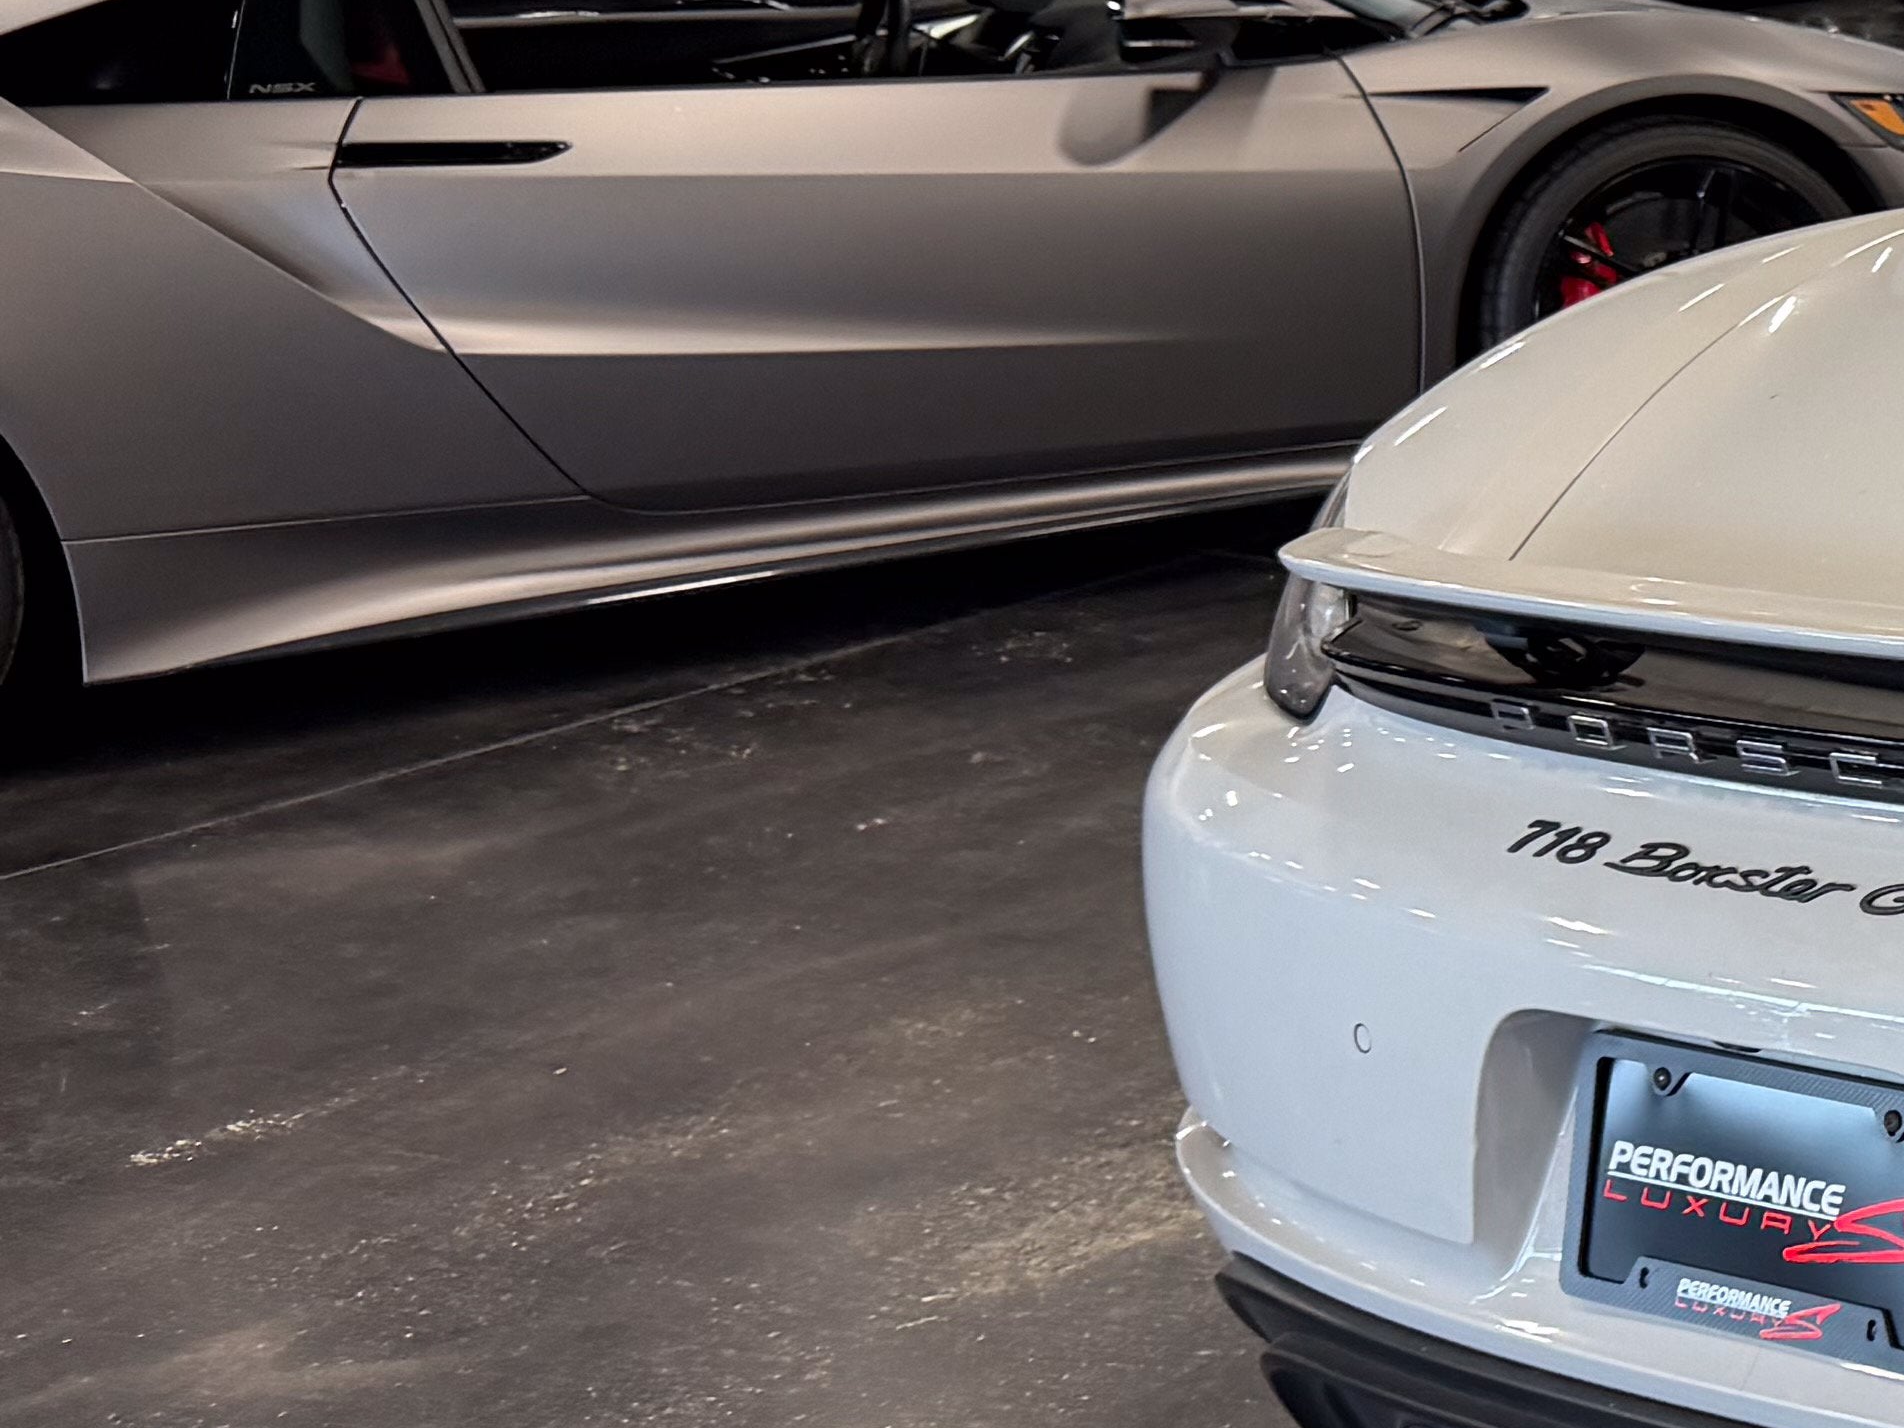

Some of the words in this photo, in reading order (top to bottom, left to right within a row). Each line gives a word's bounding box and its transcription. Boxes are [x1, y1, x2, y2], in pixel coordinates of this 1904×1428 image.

[248, 82, 316, 94] NSX
[1506, 819, 1612, 864] 718
[1603, 842, 1857, 903] Boxster
[1607, 1139, 1847, 1216] PERFORMANCE
[1603, 1178, 1831, 1241] LUXURY
[1676, 1277, 1792, 1316] PERFORMANCE
